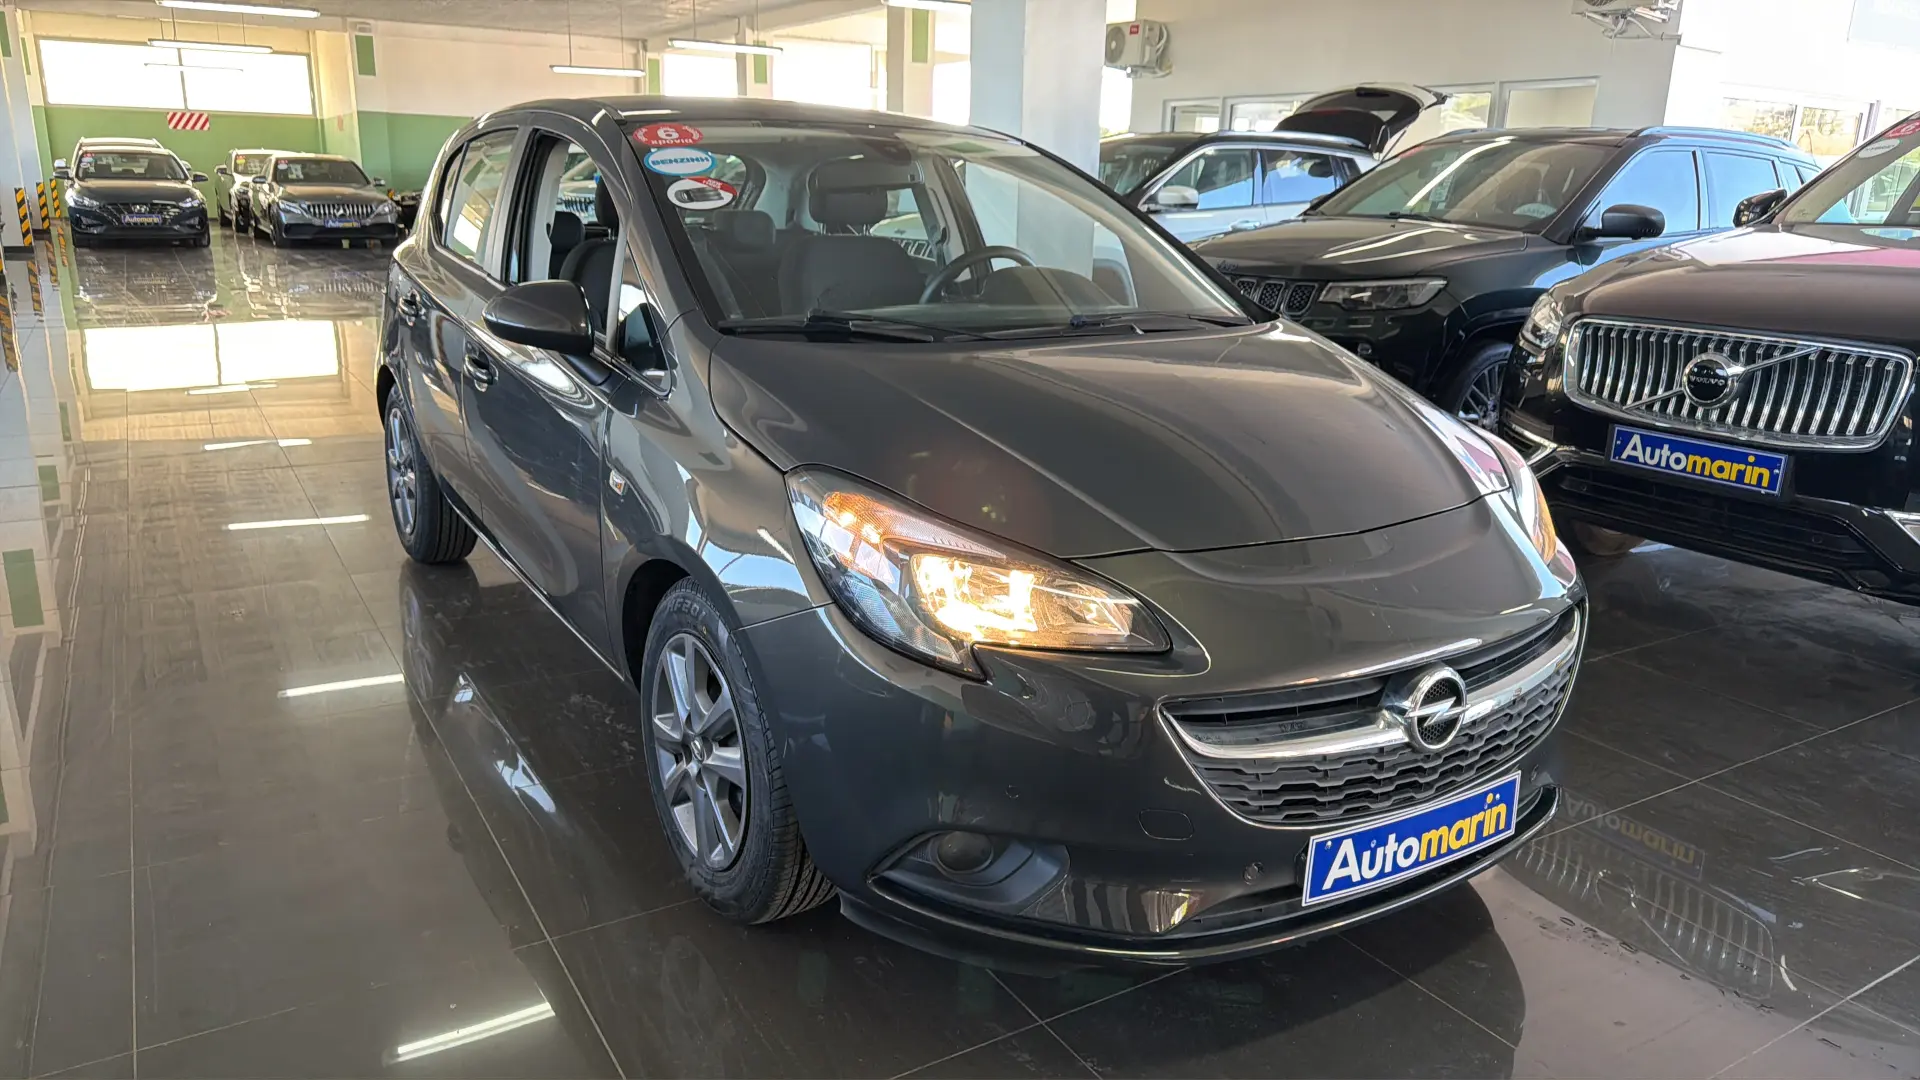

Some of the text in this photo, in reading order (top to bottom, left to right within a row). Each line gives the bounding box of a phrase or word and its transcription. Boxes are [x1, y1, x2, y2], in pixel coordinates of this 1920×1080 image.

[657, 127, 680, 140] 6
[1690, 375, 1726, 386] VOLVO
[1620, 433, 1770, 488] Automarin
[1322, 792, 1508, 891] Automarin
